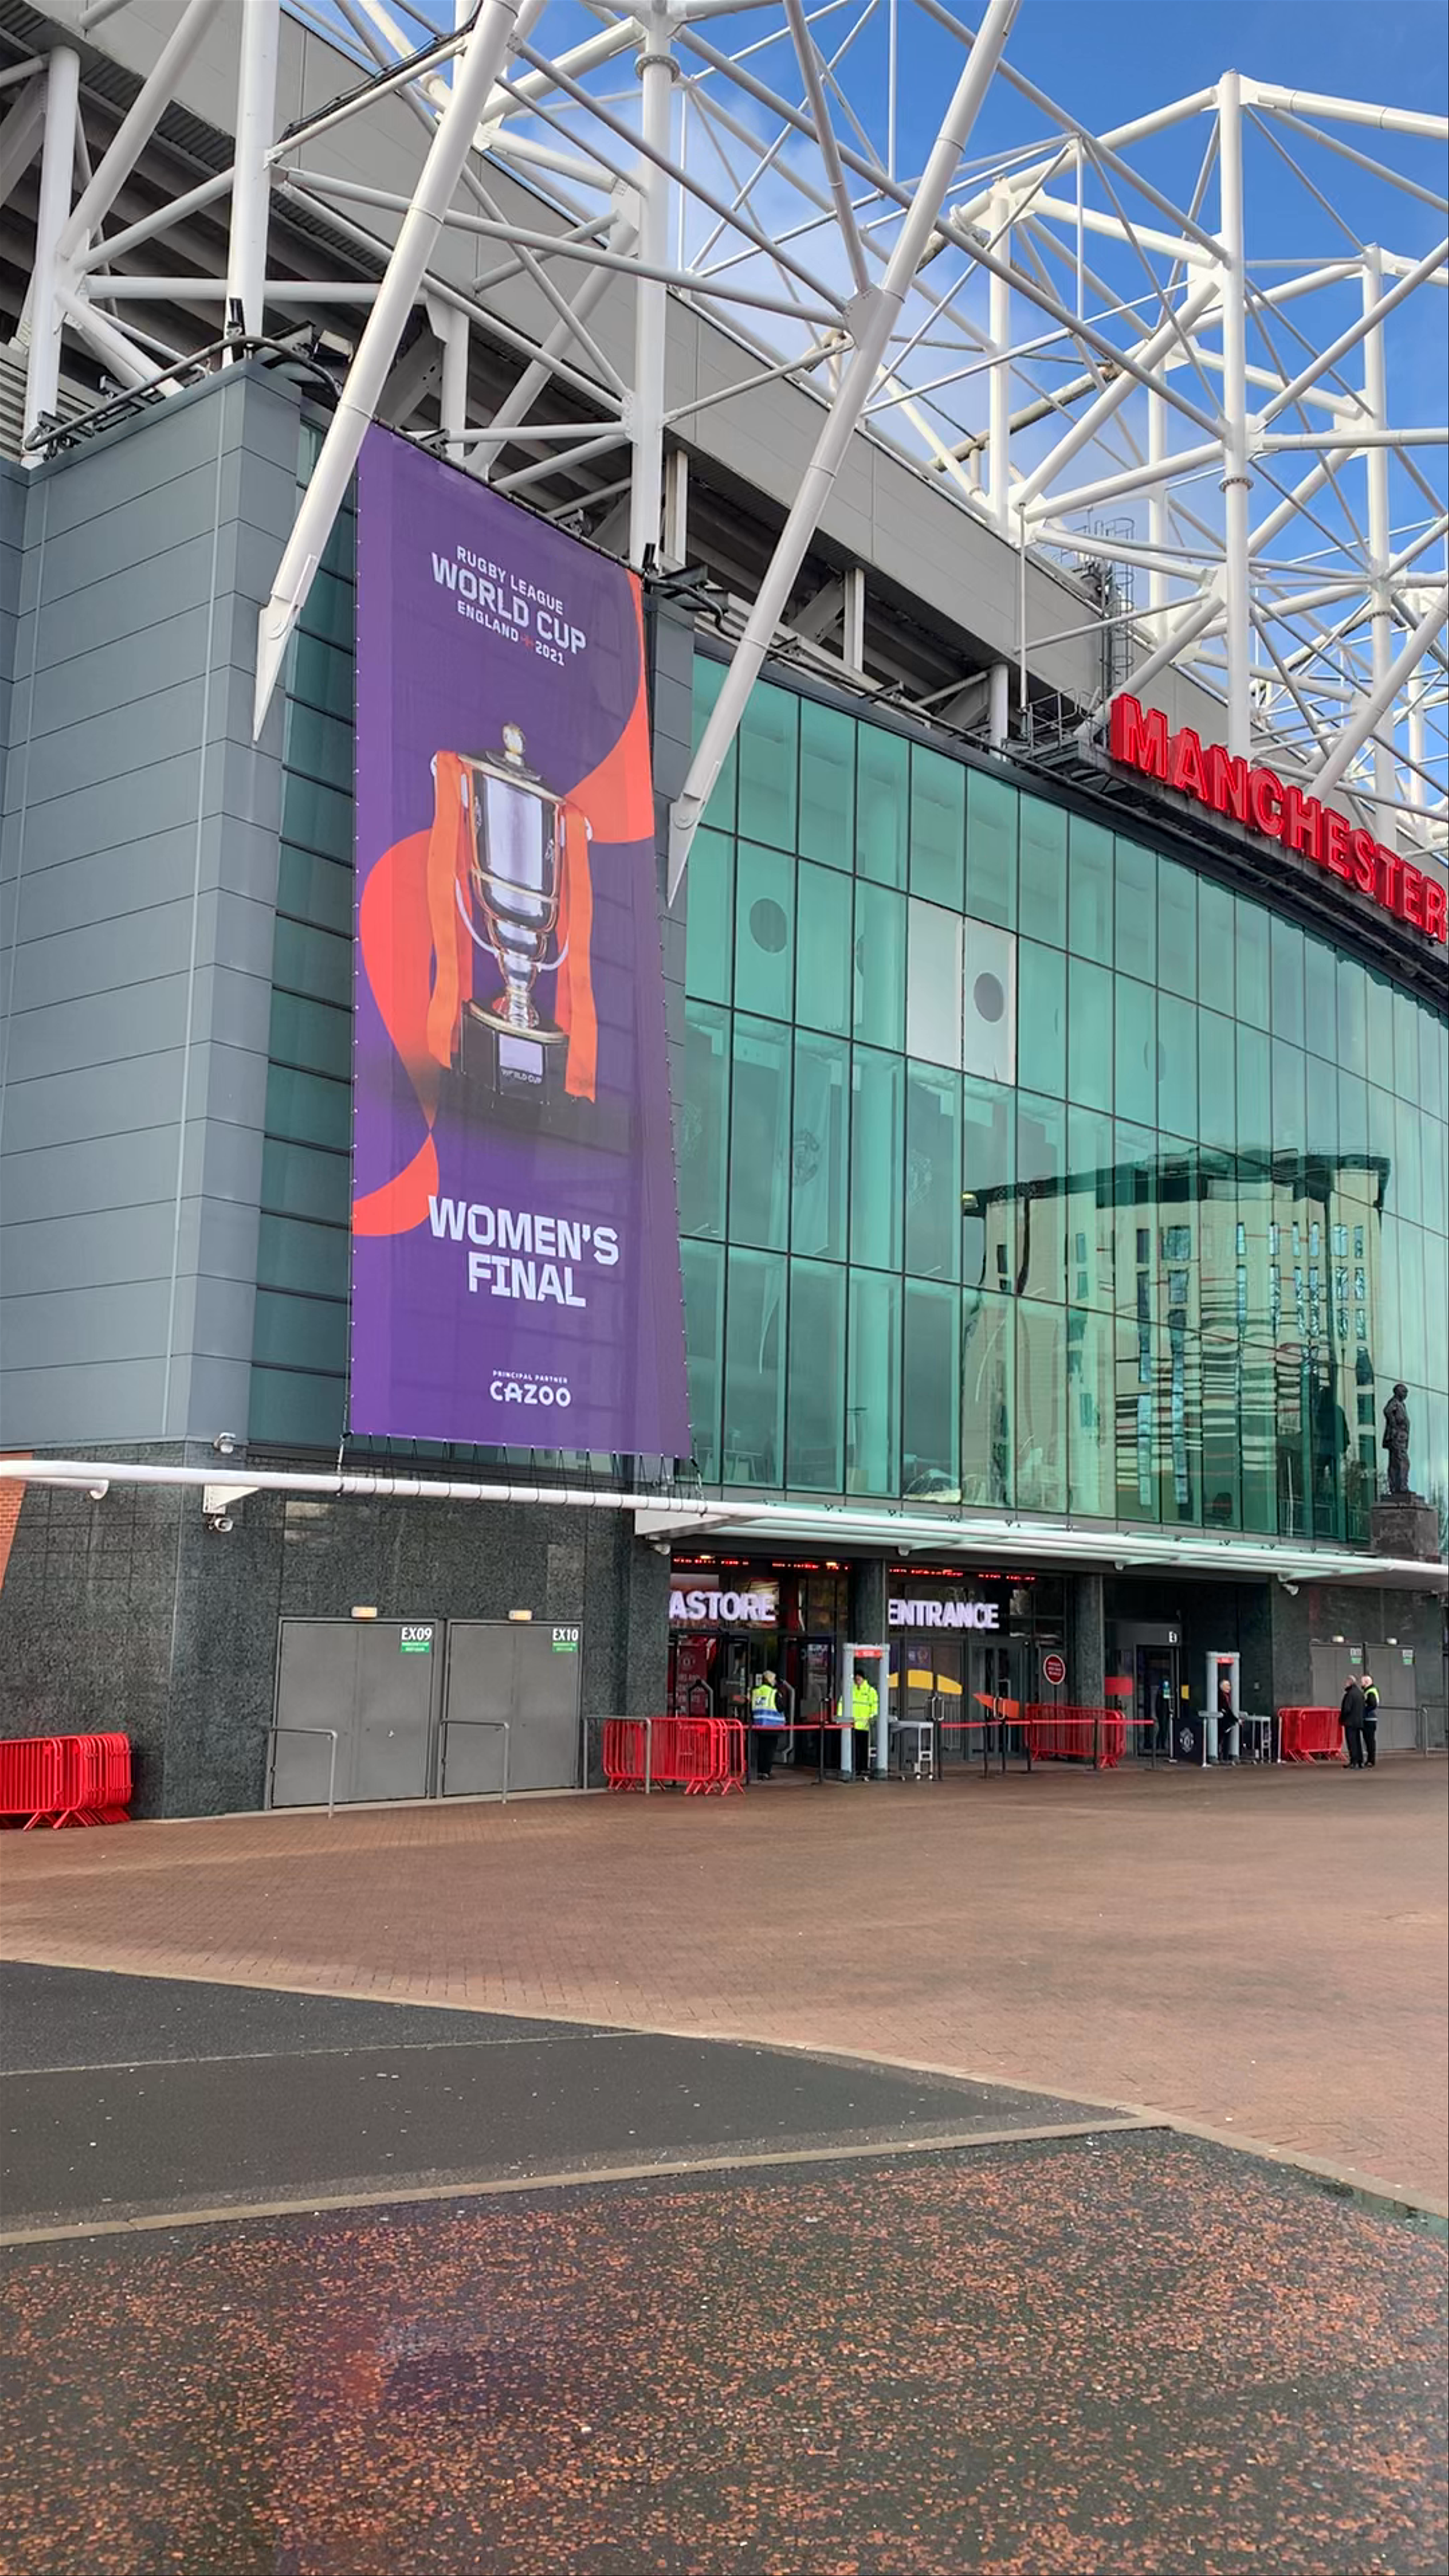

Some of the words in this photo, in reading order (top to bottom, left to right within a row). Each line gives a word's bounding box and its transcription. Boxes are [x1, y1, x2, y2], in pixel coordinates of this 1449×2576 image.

[432, 552, 529, 627] WORLD
[537, 611, 586, 654] CUP
[457, 546, 506, 583] RUGBY
[511, 575, 563, 615] LEAGUE
[458, 600, 518, 642] ENGLAND
[535, 641, 565, 666] 2021
[1111, 692, 1447, 943] MANCHESTER
[428, 1195, 618, 1265] WOMEN'S
[469, 1251, 586, 1307] FINAL
[490, 1381, 571, 1407] CAZOO
[493, 1370, 532, 1381] PRINCIPAL
[535, 1374, 568, 1384] PARTNER
[401, 1627, 432, 1641] EX09
[553, 1628, 578, 1641] EX10
[888, 1599, 999, 1628] ENTRANCE
